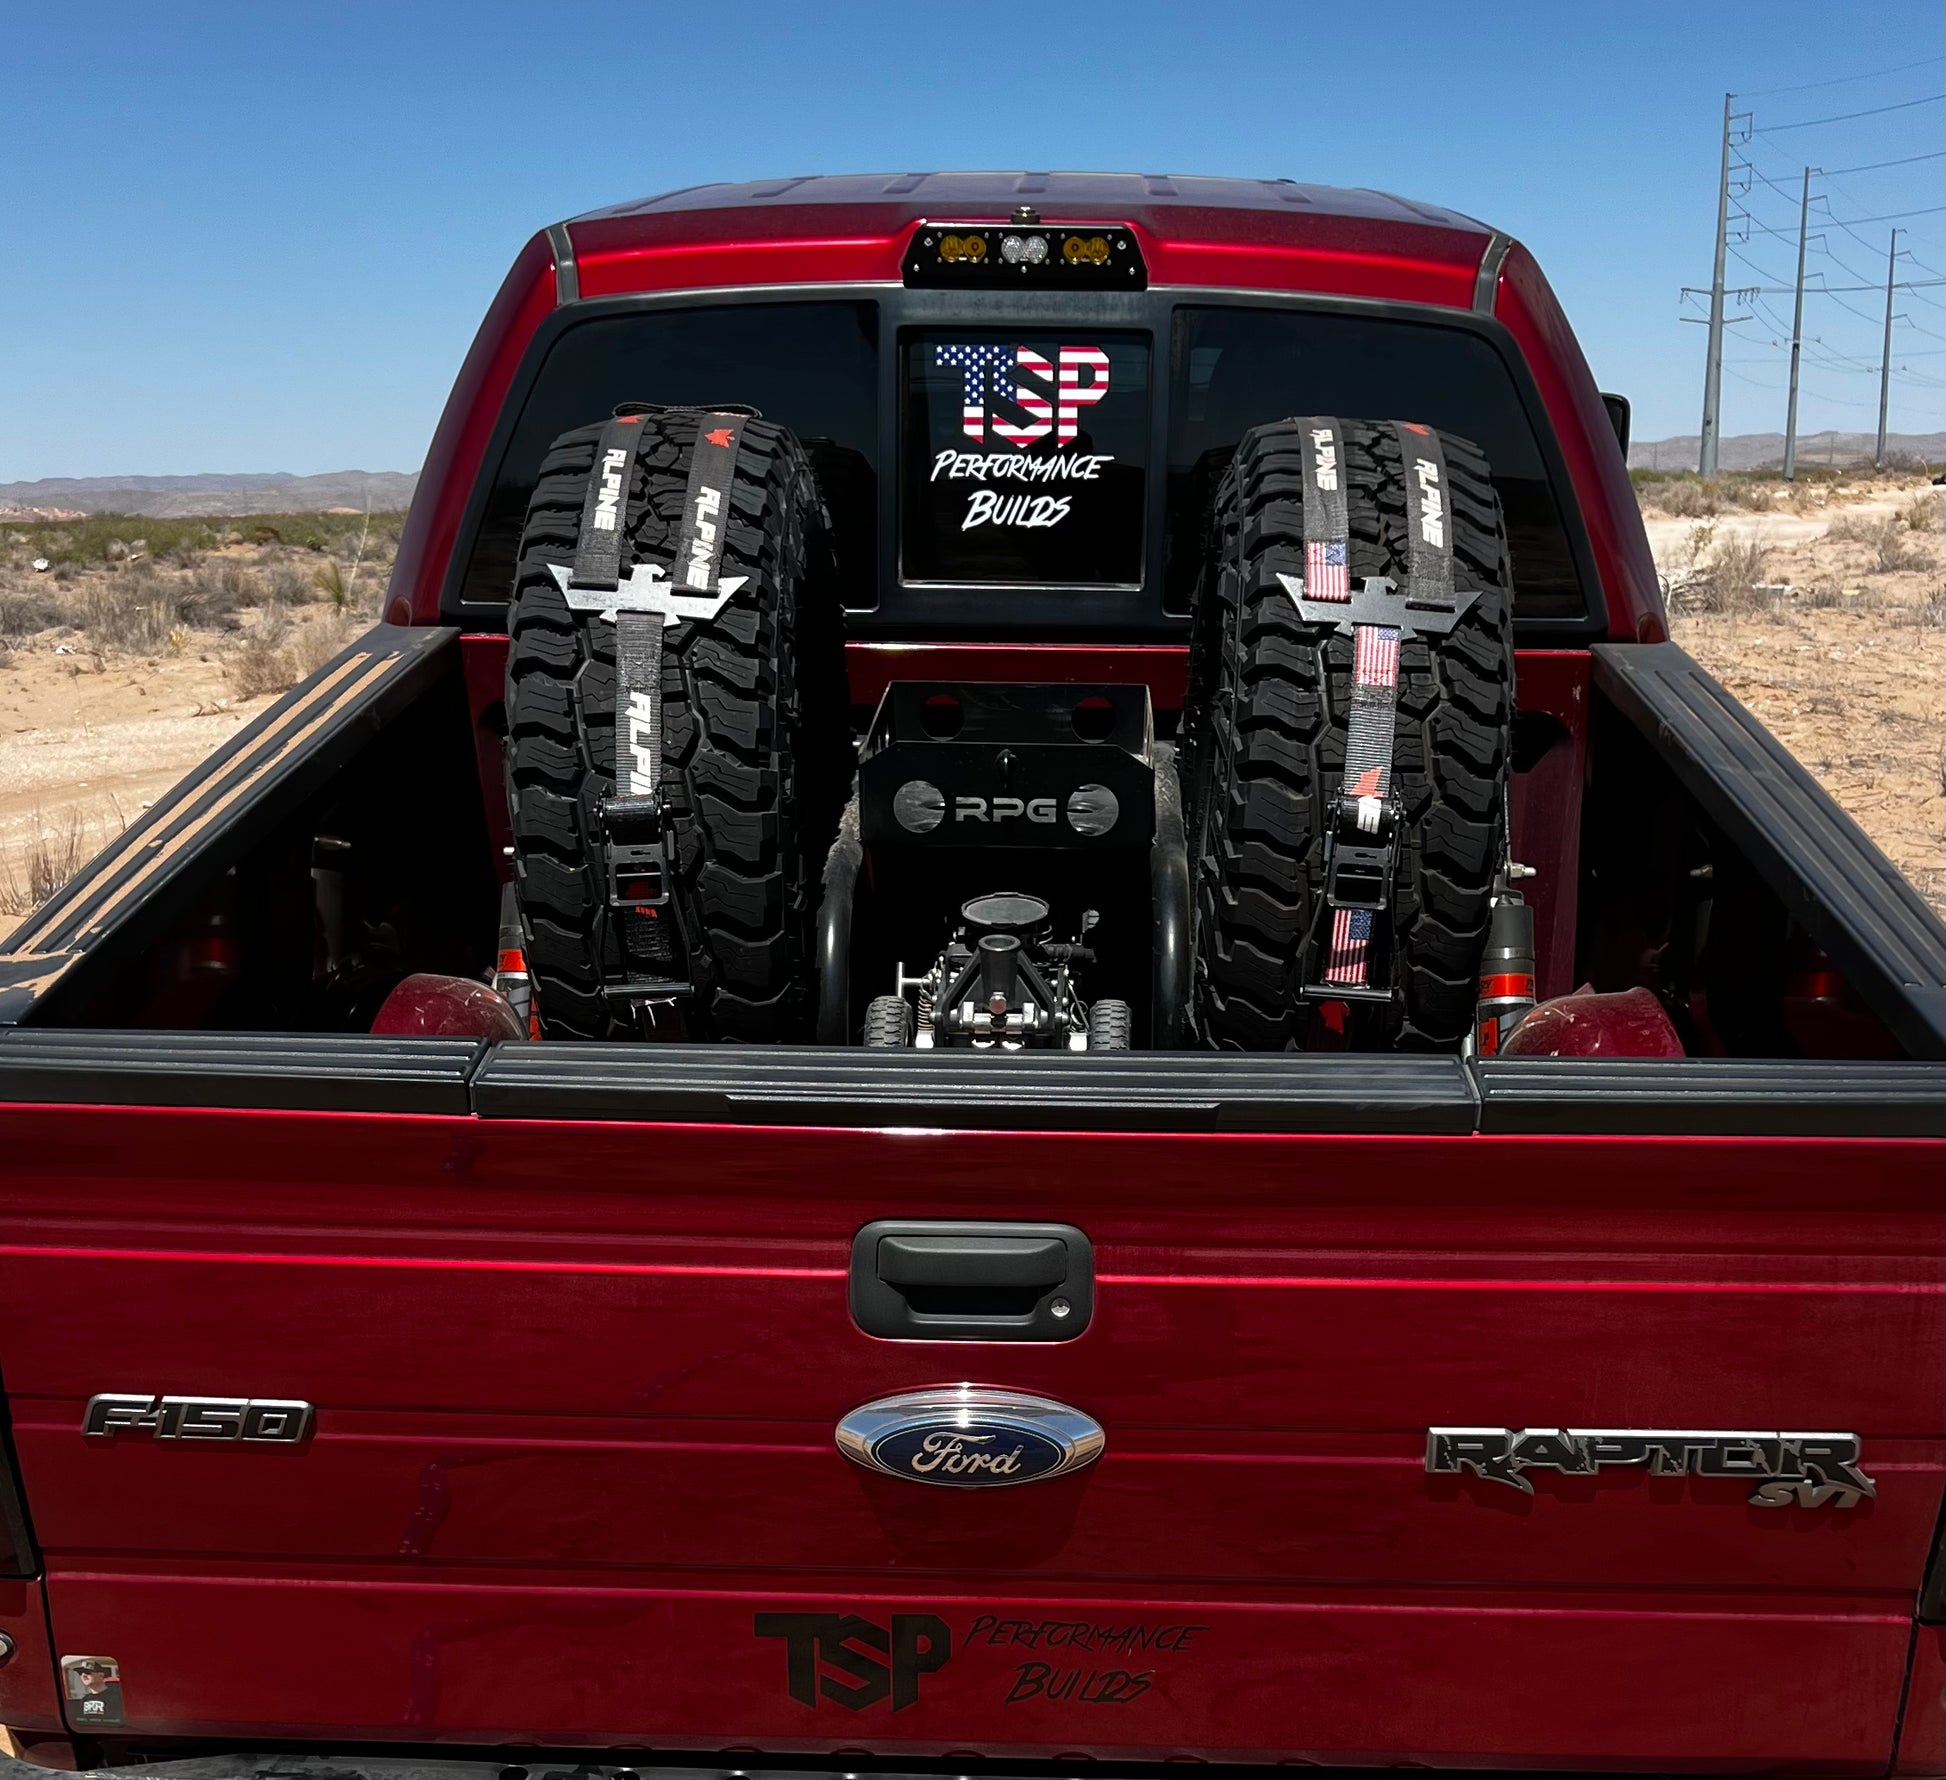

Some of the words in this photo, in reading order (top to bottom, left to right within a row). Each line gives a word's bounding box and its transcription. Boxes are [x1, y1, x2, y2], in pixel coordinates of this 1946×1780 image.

[934, 344, 1110, 449] TSP
[930, 449, 1115, 482] PERFORMANCE
[1309, 428, 1338, 491] ALPINE
[594, 448, 628, 531] ALPINE
[961, 489, 1072, 532] BUILDS
[1412, 457, 1444, 549] ALPINE
[686, 486, 721, 590] ALPINE
[955, 797, 1057, 824] RPG
[80, 1393, 315, 1443] F-150
[911, 1431, 1024, 1474] Ford
[1424, 1427, 1877, 1499] RAPTOR
[1748, 1480, 1861, 1508] SVT
[753, 1612, 951, 1713] TSP
[962, 1615, 1210, 1653] PERFORMANCE
[1004, 1661, 1156, 1705] BUILDS
